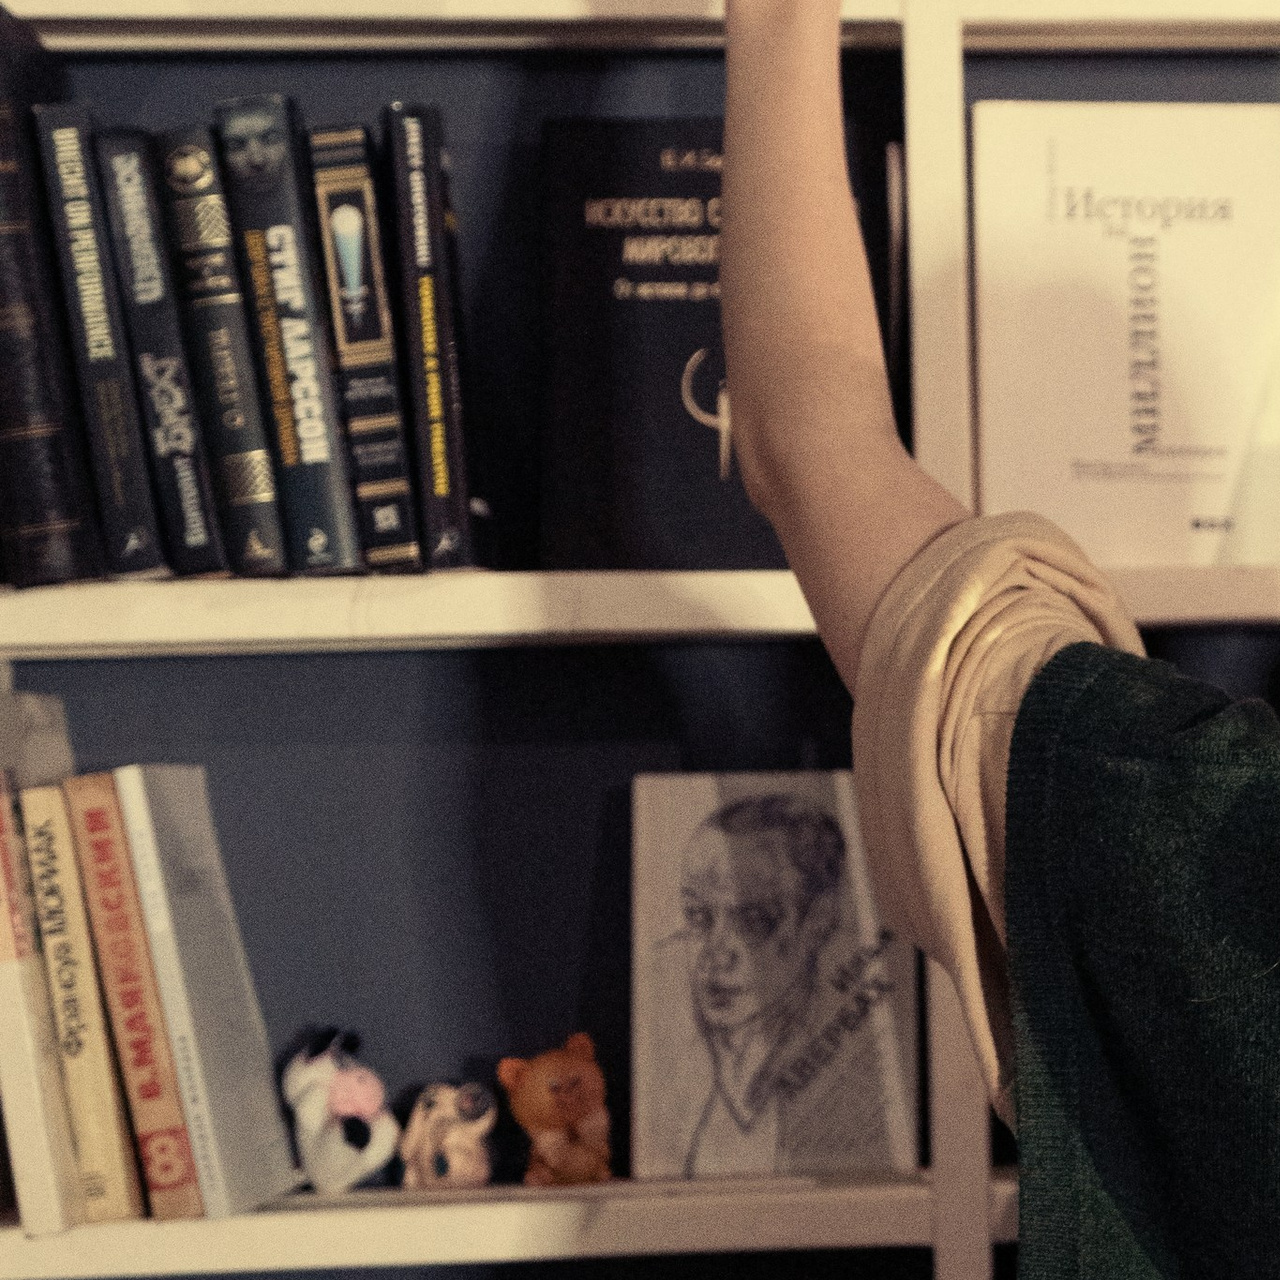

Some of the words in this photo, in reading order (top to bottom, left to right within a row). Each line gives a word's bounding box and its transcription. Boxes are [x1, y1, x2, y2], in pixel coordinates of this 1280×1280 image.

[62, 198, 89, 229] ON
[1063, 185, 1234, 228] История
[68, 229, 119, 362] PERFORMANCE
[266, 224, 306, 318] СТИГ
[279, 316, 329, 465] ЛАРССОН
[29, 819, 68, 937] МОРИАК
[772, 977, 898, 1099] АВЕРБАХ
